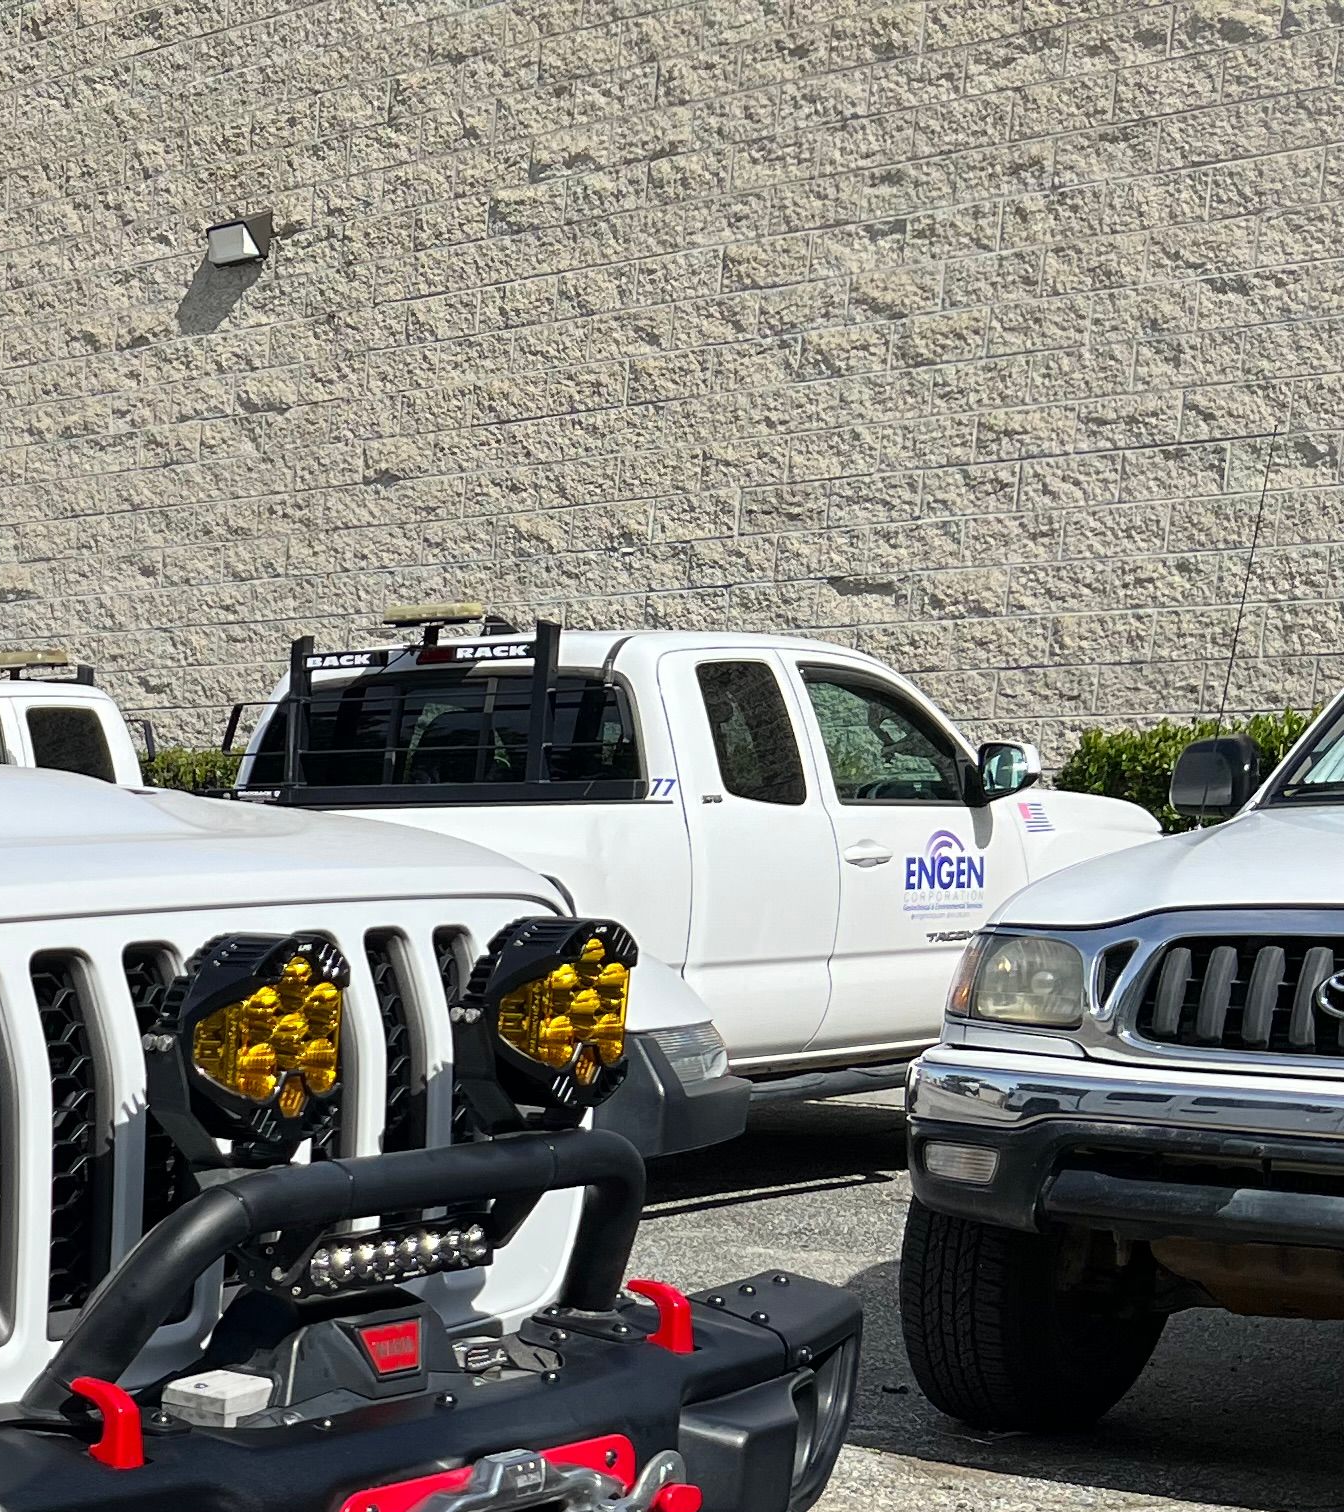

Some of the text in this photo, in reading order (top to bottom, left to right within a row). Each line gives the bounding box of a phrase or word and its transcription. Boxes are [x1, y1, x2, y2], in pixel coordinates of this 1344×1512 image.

[306, 644, 528, 668] BACK RACK
[651, 778, 676, 797] 77
[905, 856, 984, 890] ENGEN
[903, 891, 984, 903] CORPORATION
